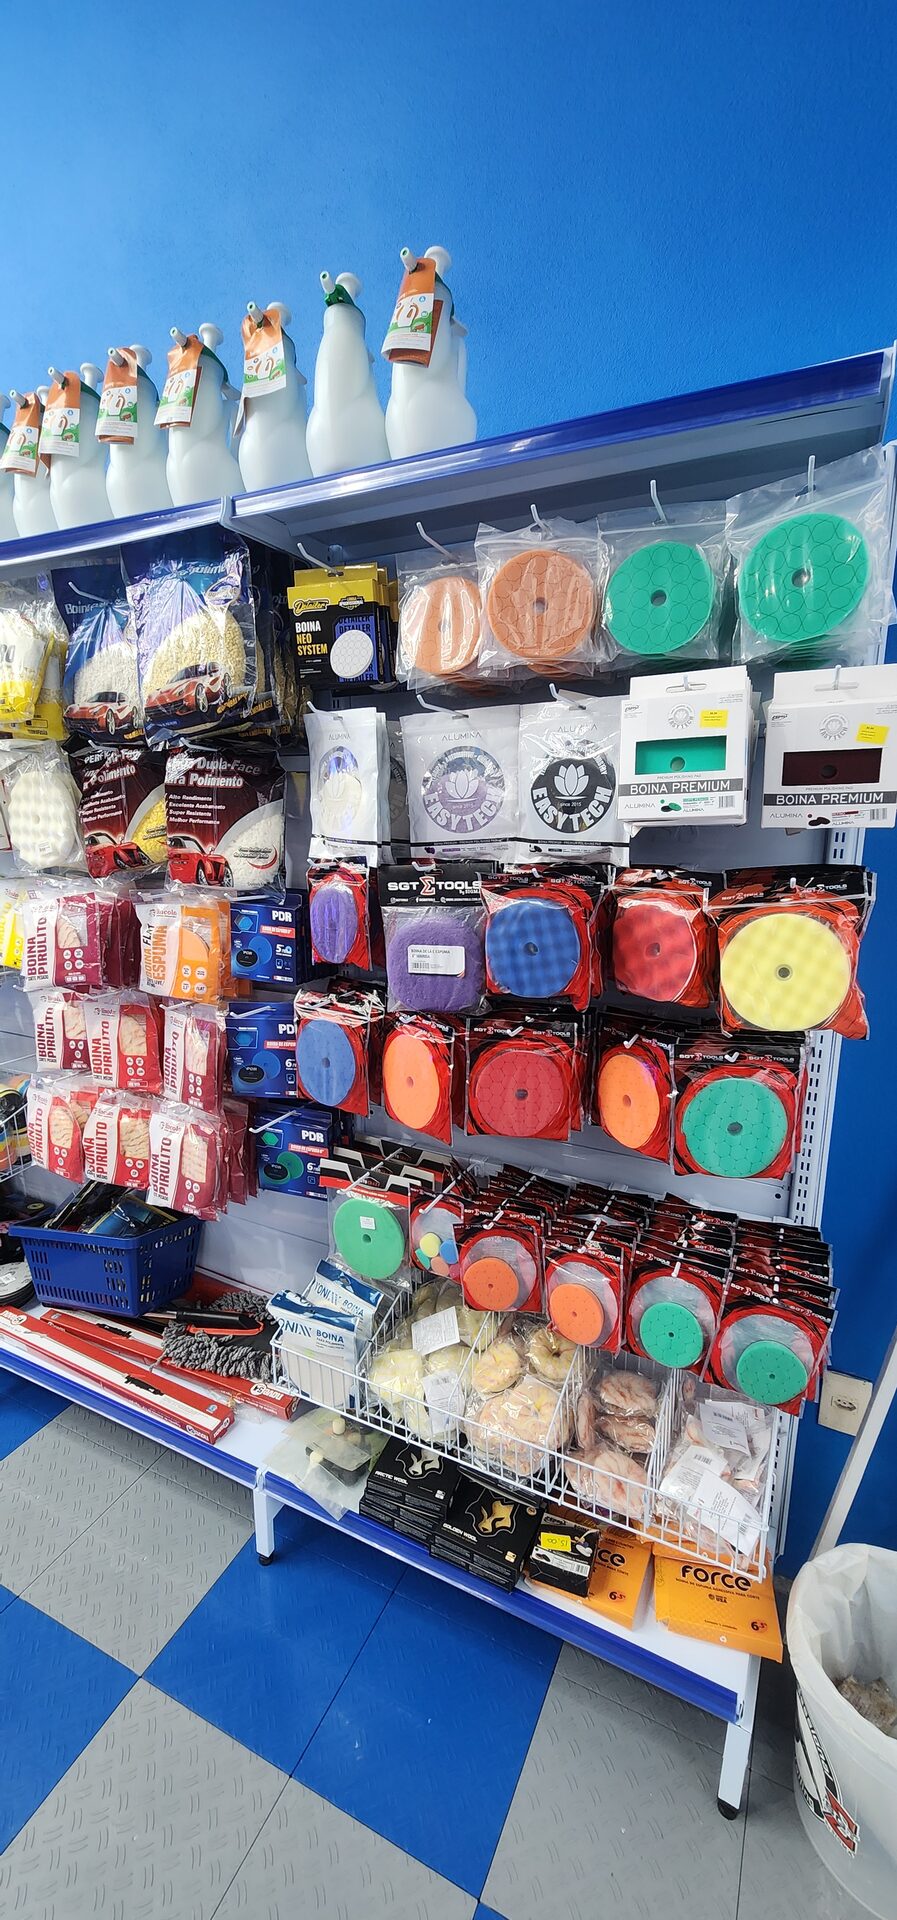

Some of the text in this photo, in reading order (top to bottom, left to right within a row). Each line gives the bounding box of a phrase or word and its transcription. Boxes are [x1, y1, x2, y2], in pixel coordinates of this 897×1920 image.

[295, 620, 321, 633] BOINA
[296, 633, 312, 644] NEO
[298, 644, 328, 656] SYSTEM
[442, 732, 482, 741] ALUMINA
[197, 757, 260, 774] Dupla-Face
[190, 773, 244, 787] Polimento
[630, 780, 730, 794] BOINA PREMIUM
[776, 793, 883, 804] BOINA PREMIUM
[424, 784, 504, 831] EASYTECH
[532, 786, 612, 832] EASYTECH
[388, 881, 482, 890] SGT TOOLS
[272, 910, 292, 922] PDR
[143, 924, 154, 945] FLAT
[37, 916, 48, 974] PIRULITO
[27, 936, 37, 976] BOINA
[45, 1007, 56, 1058] PIRULITO
[278, 1024, 296, 1034] PD
[37, 1023, 46, 1057] BOINA
[92, 1038, 102, 1074] BOINA
[102, 1021, 113, 1076] PIRULITO
[301, 1130, 324, 1142] PDR
[96, 1121, 107, 1175] PIRULITO
[159, 1137, 172, 1196] PIRULITO
[752, 1291, 771, 1303] TOOLS
[342, 1299, 364, 1317] BOINA
[317, 1330, 344, 1343] BOINA
[375, 1470, 408, 1484] ARCTIC WOOL
[443, 1523, 477, 1542] GOLDEN WOOL
